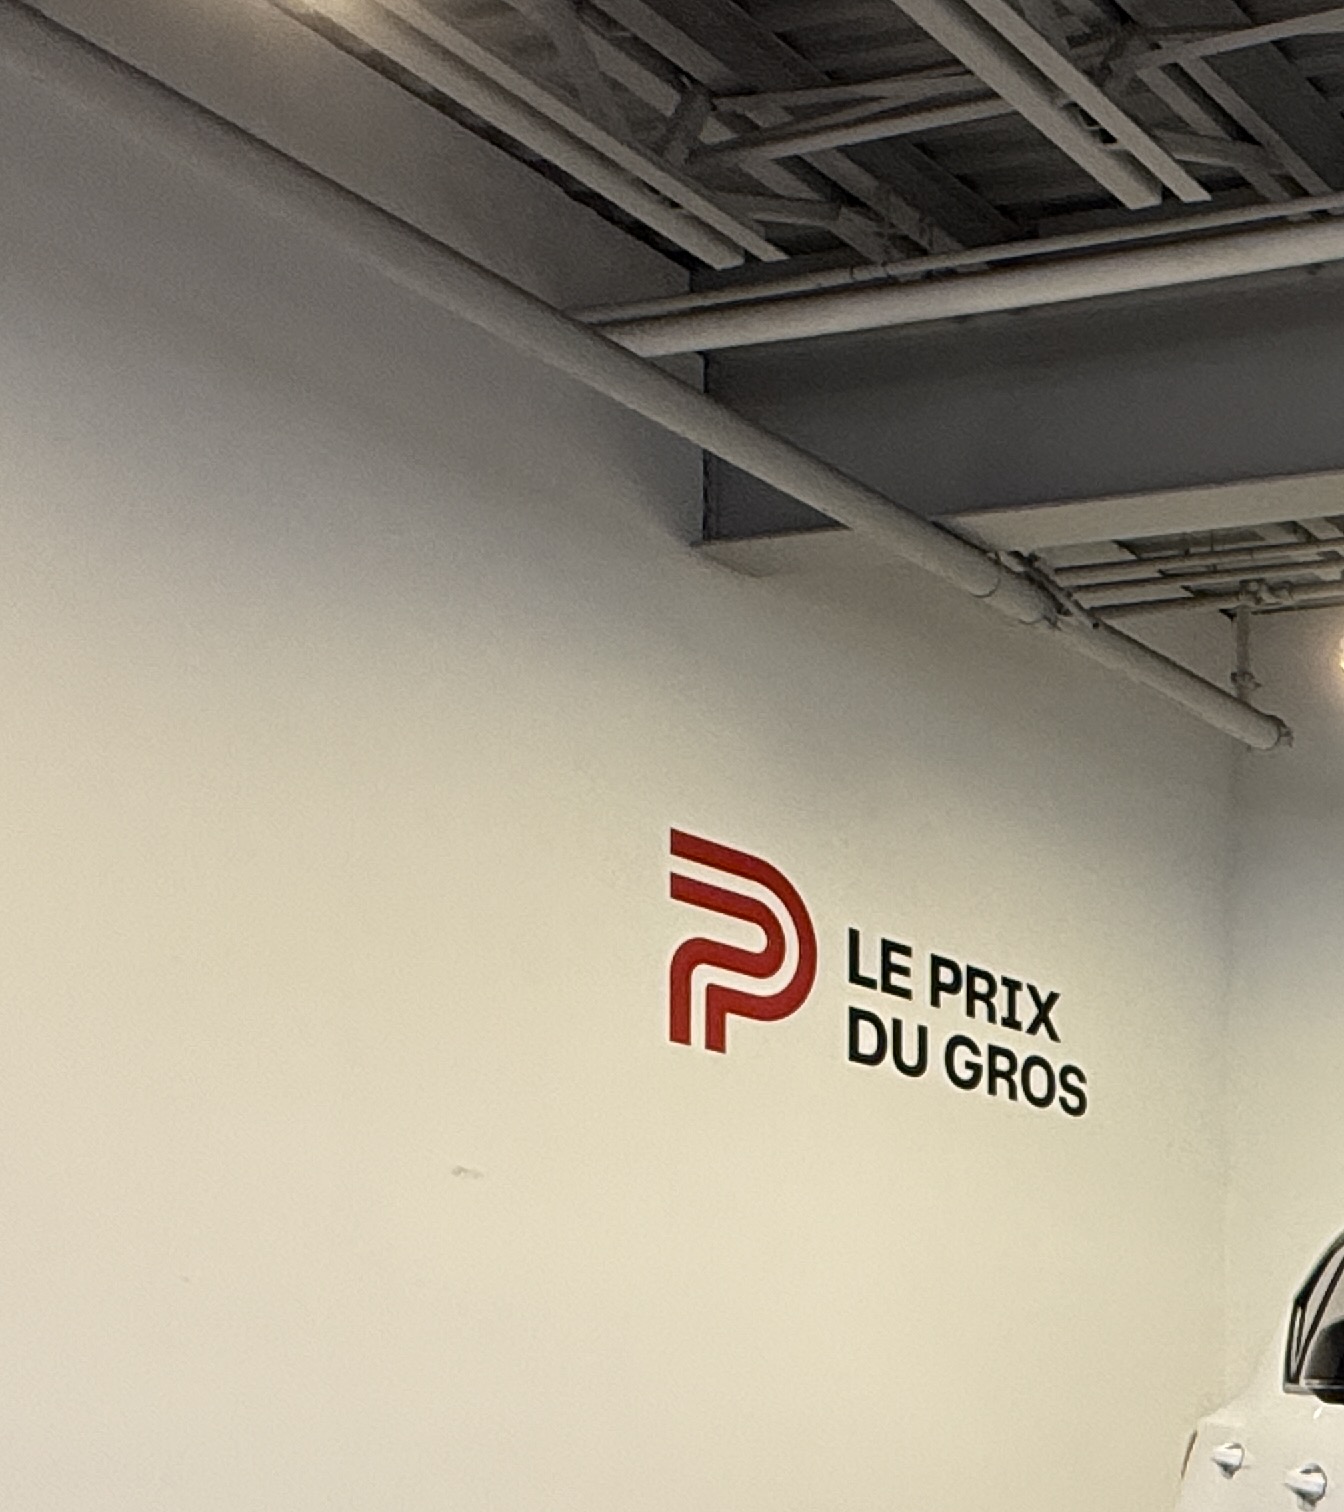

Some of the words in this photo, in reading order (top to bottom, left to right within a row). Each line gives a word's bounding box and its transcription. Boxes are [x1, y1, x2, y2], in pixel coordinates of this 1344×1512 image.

[848, 927, 913, 1001] LE
[930, 953, 1061, 1043] PRIX
[848, 1006, 928, 1078] DU
[944, 1035, 1088, 1118] GROS
